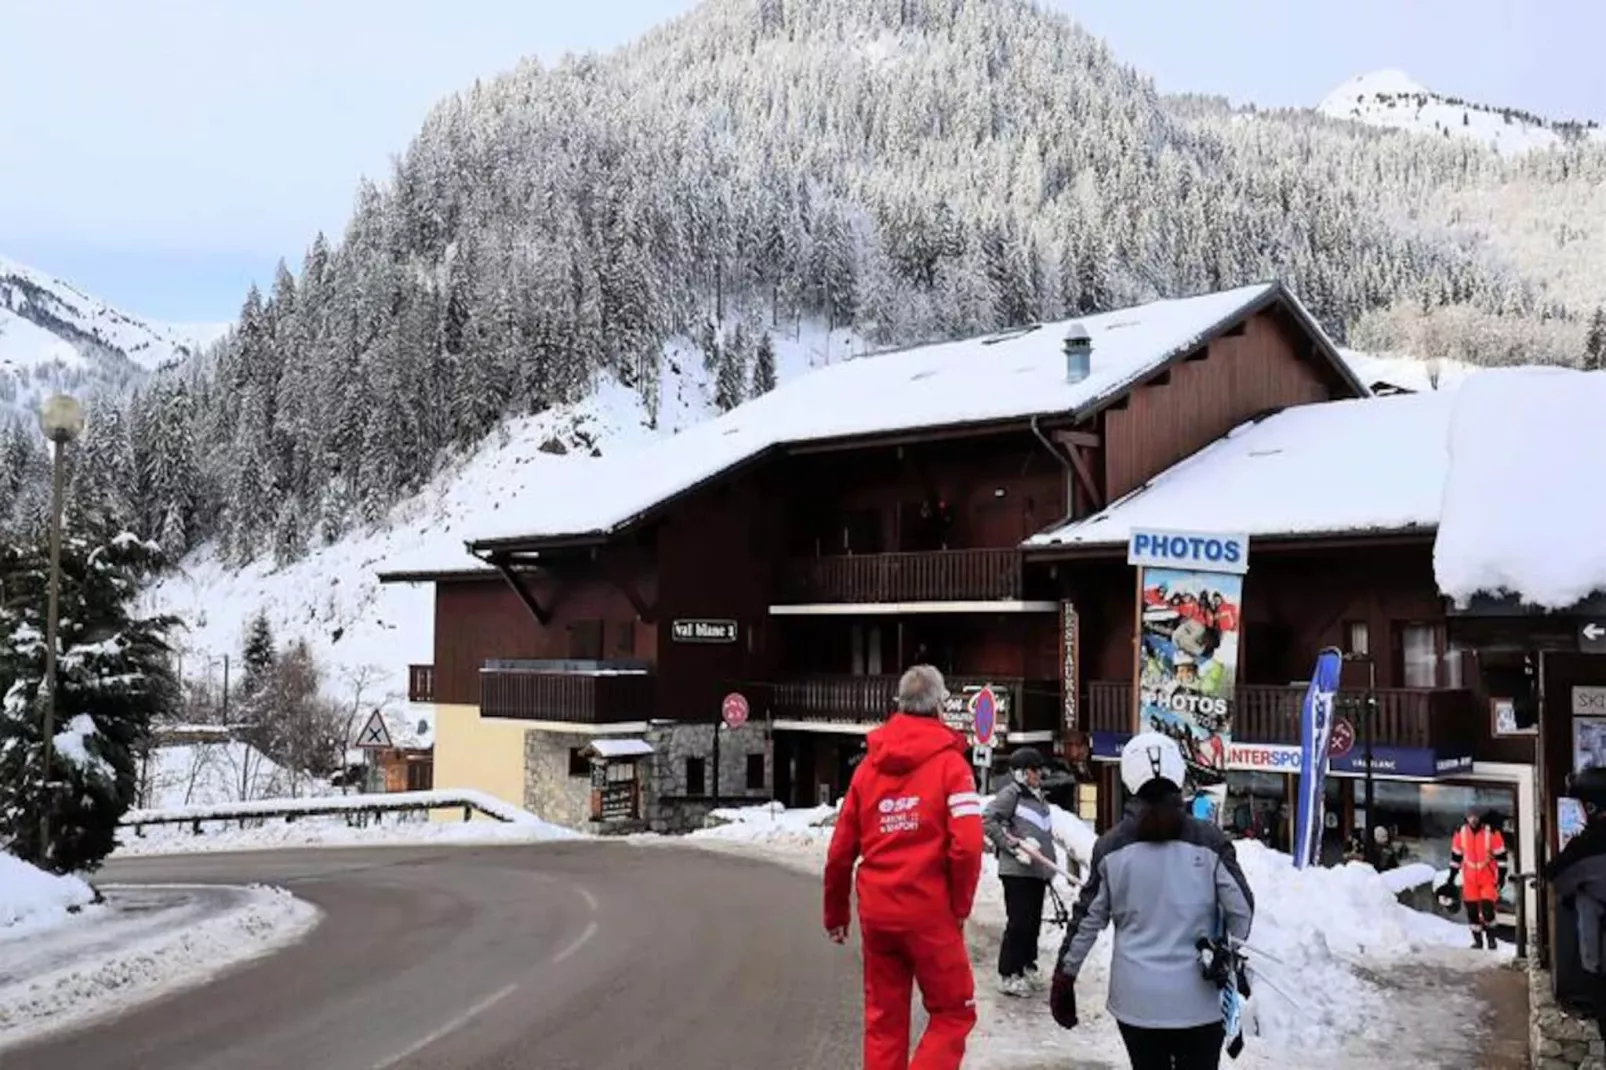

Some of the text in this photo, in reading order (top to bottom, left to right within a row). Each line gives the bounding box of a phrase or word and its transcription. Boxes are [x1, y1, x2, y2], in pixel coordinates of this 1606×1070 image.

[1133, 533, 1241, 563] PHOTOS
[675, 623, 693, 637] val
[695, 622, 726, 637] blanc
[1064, 602, 1076, 730] RESTAURANT
[1147, 690, 1228, 715] PHOTOS
